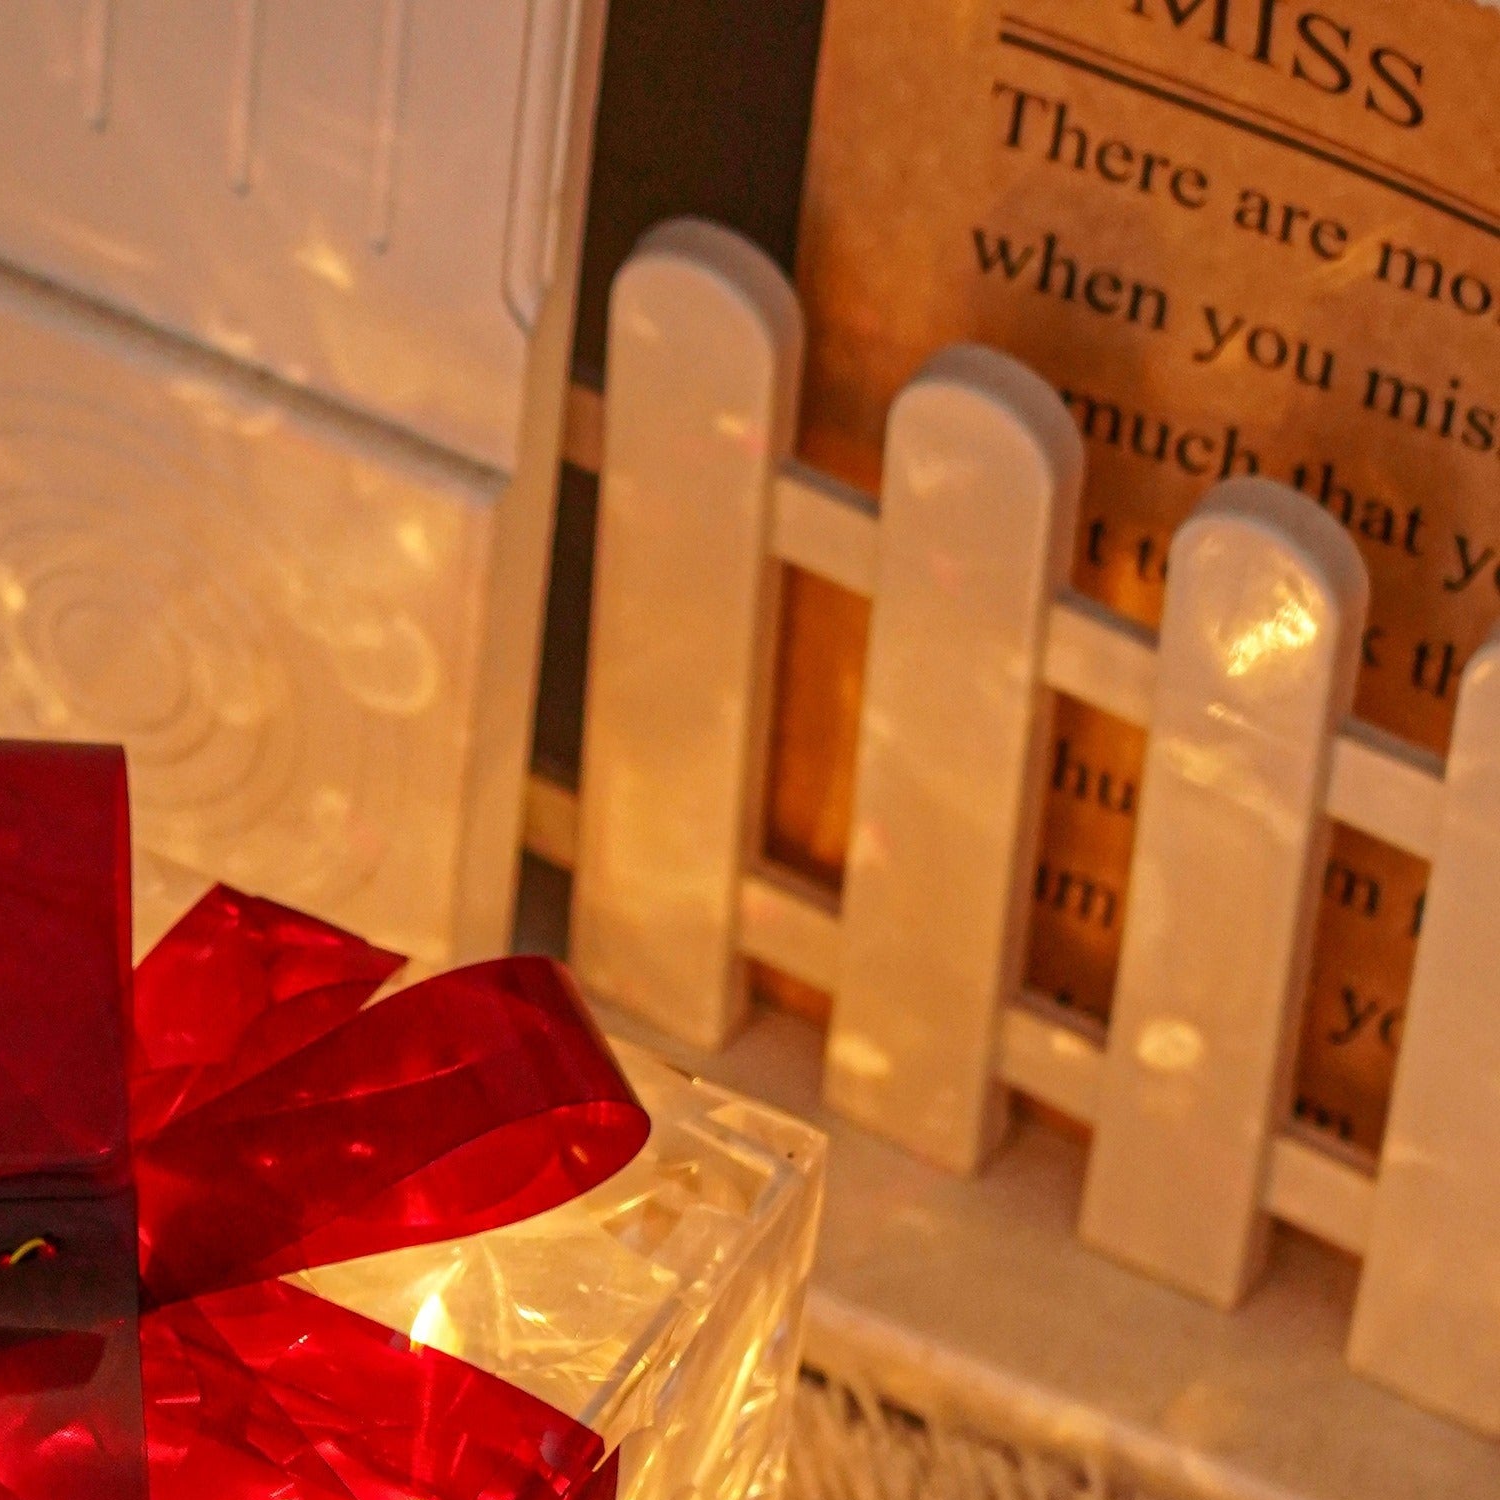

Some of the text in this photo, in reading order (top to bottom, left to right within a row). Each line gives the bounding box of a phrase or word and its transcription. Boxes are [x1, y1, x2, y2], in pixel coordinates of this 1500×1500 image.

[993, 81, 1500, 327] There are mo
[971, 226, 1500, 462] when you mis
[1060, 388, 1260, 481] much
